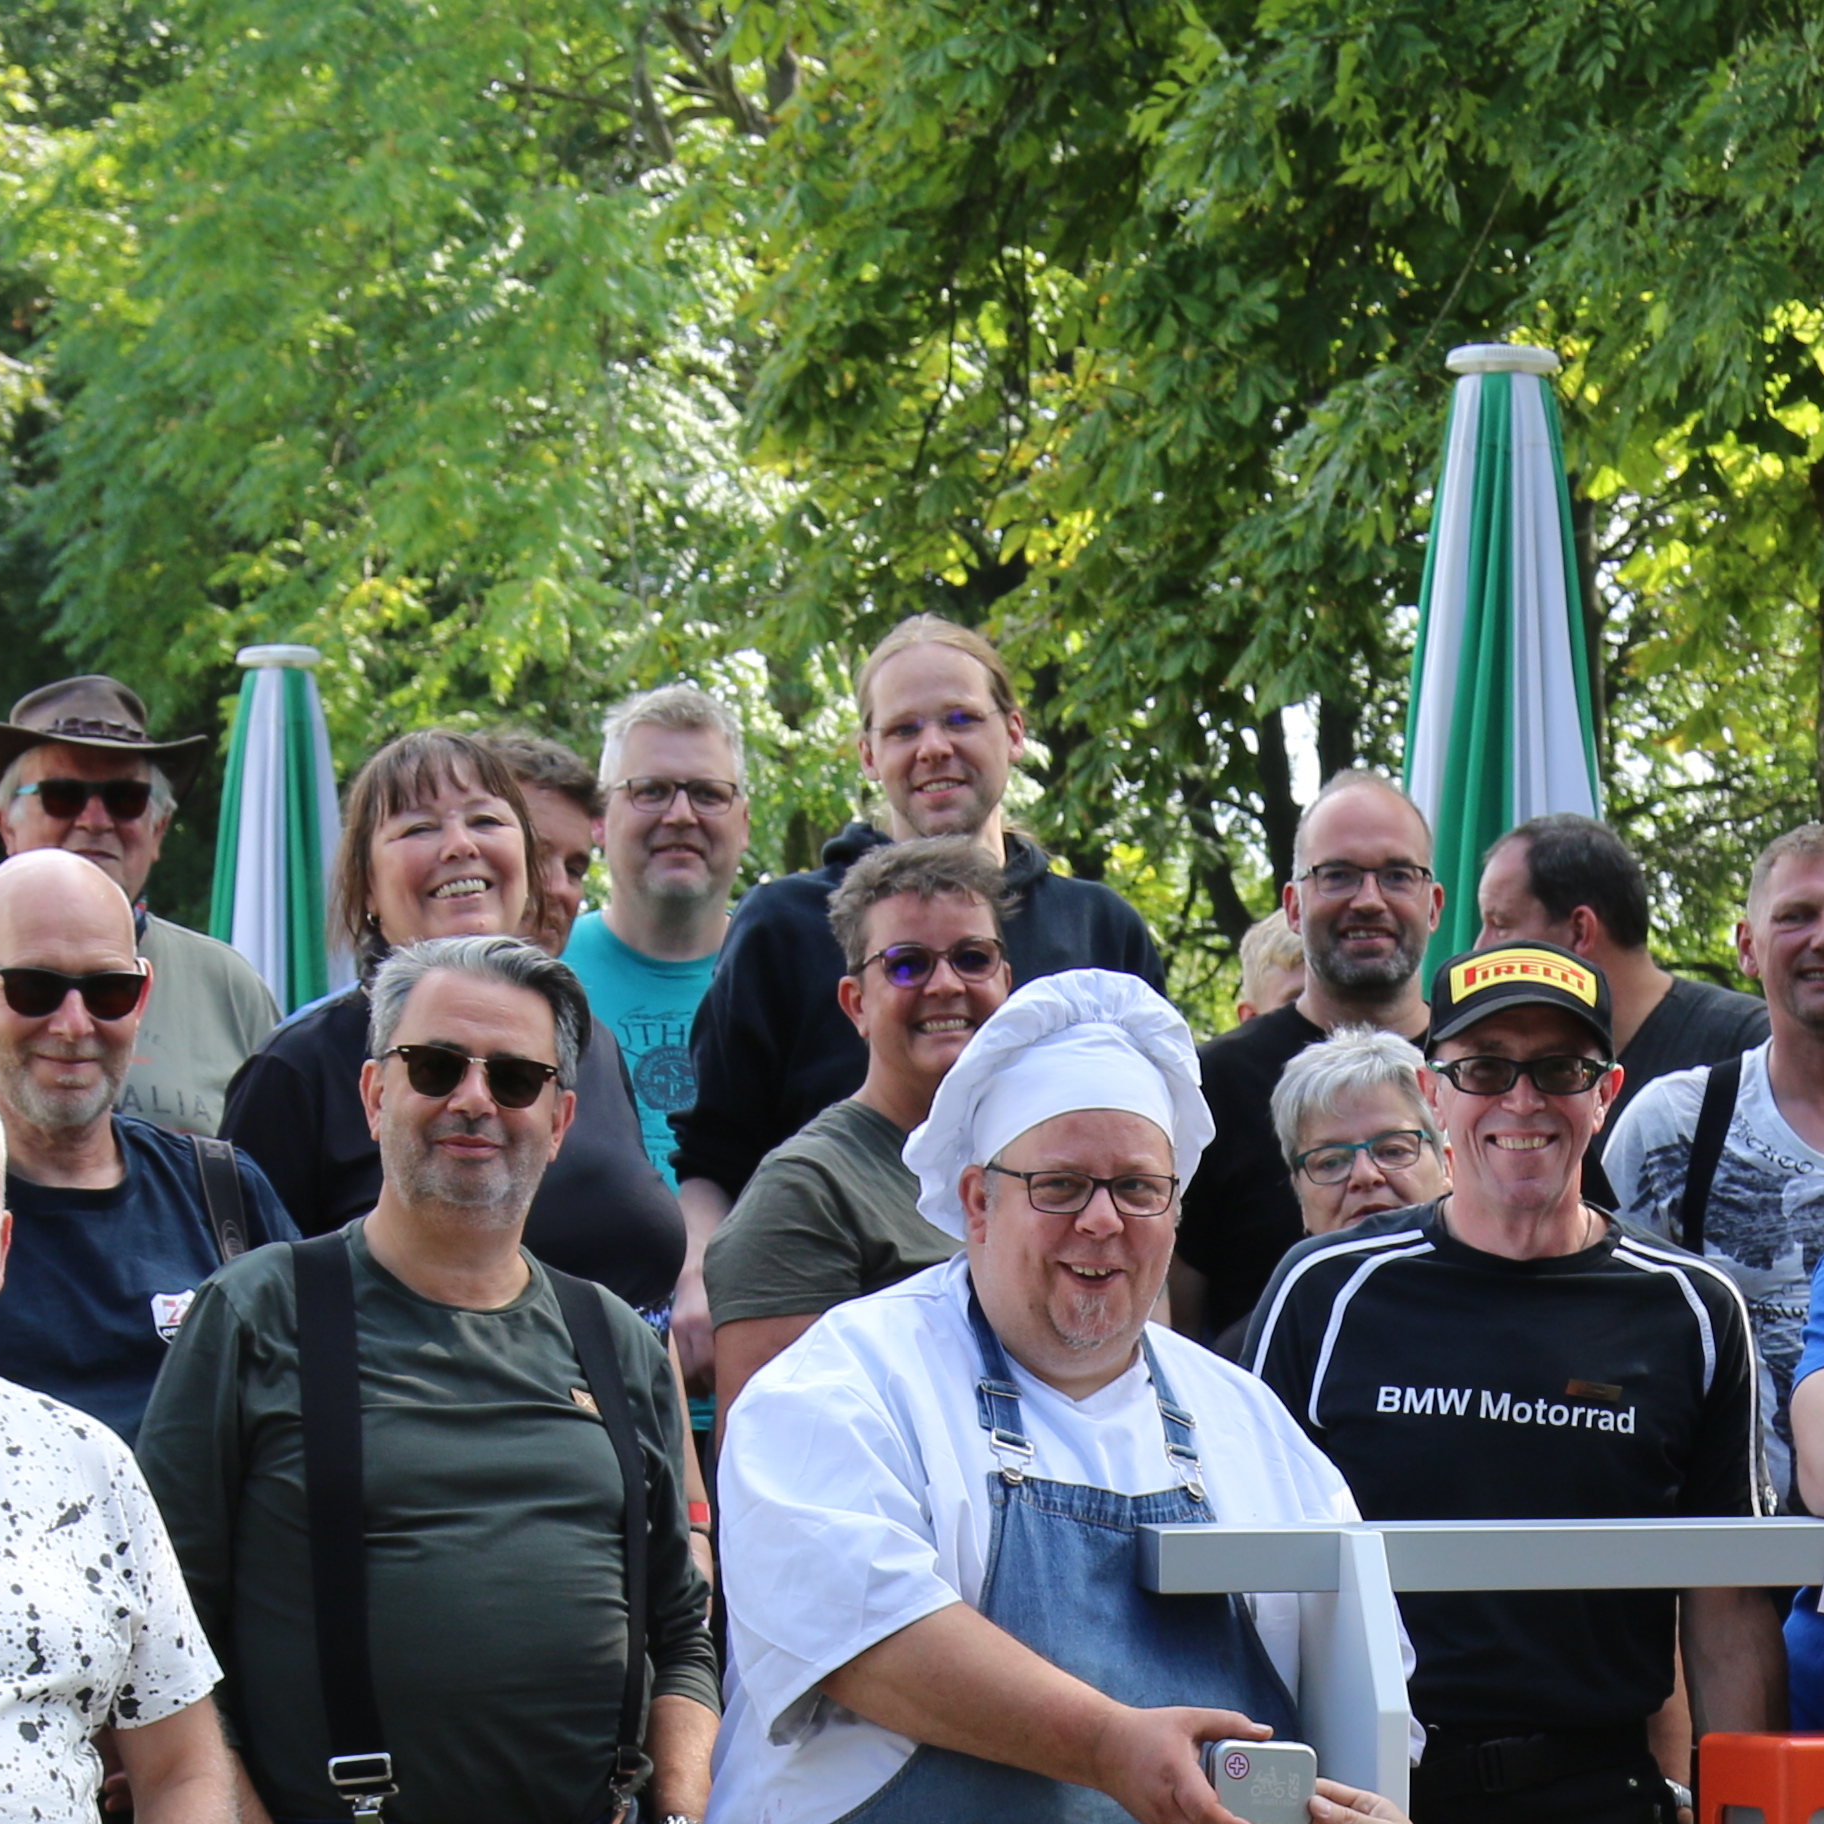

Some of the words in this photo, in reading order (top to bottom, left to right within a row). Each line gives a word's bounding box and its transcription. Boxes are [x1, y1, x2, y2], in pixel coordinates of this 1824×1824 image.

[1464, 956, 1586, 991] PIRELLI
[113, 1083, 211, 1123] ALIA
[1376, 1386, 1473, 1416] BMW
[1479, 1390, 1635, 1434] Motorrad
